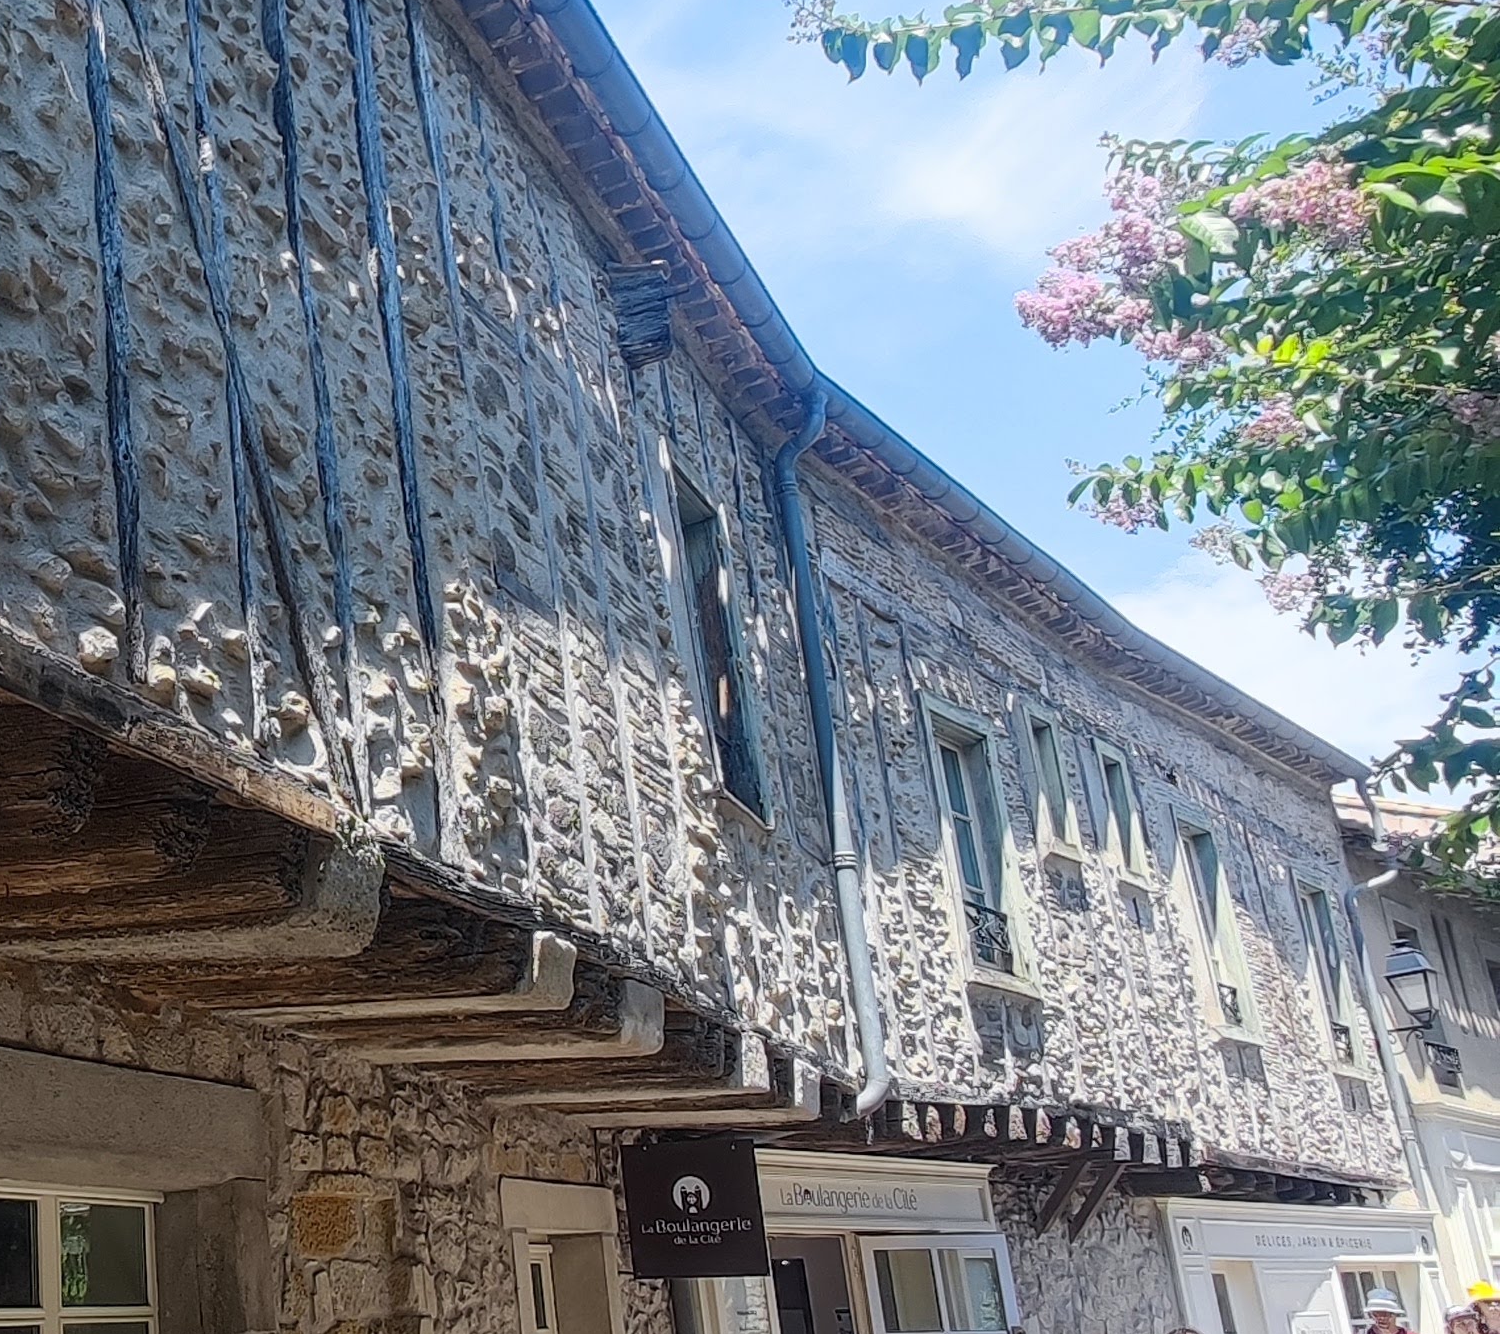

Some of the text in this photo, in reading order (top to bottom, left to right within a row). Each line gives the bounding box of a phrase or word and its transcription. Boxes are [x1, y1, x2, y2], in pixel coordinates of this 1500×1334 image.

[780, 1187, 793, 1206] La
[793, 1183, 870, 1214] Boulangerie
[872, 1193, 884, 1209] de
[892, 1187, 917, 1211] Cité
[641, 1216, 752, 1235] La Boulangerie
[673, 1233, 722, 1245] de la Cité
